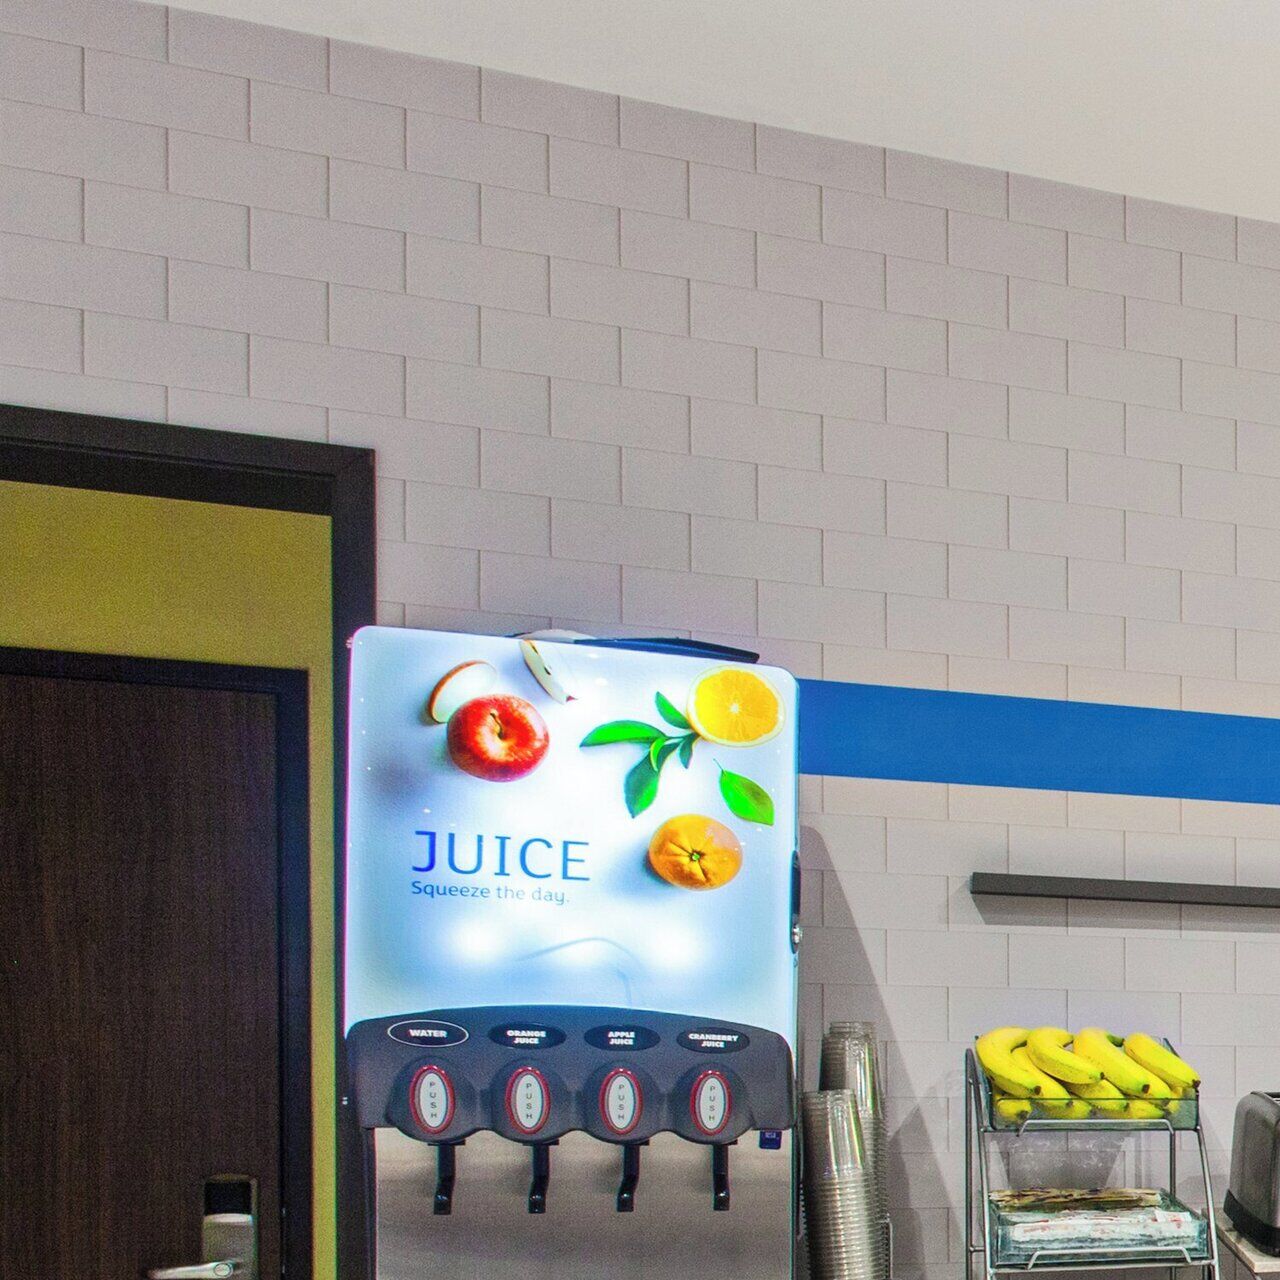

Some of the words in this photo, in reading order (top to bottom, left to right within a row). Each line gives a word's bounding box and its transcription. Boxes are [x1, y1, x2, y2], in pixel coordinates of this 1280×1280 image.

[411, 829, 590, 882] JUICE
[411, 879, 491, 900] Squeeze
[496, 884, 526, 900] the
[531, 886, 570, 905] day.
[408, 1028, 448, 1039] WATER
[506, 1029, 546, 1038] ORANGE
[513, 1037, 540, 1045] JUICE
[607, 1031, 636, 1039] APPLE
[609, 1038, 634, 1046] JUICE
[688, 1032, 739, 1042] CRANBERRY
[428, 1080, 438, 1119] PUSH
[525, 1082, 533, 1120] PUSH
[617, 1084, 626, 1121] PUSH
[708, 1085, 717, 1122] PUSH
